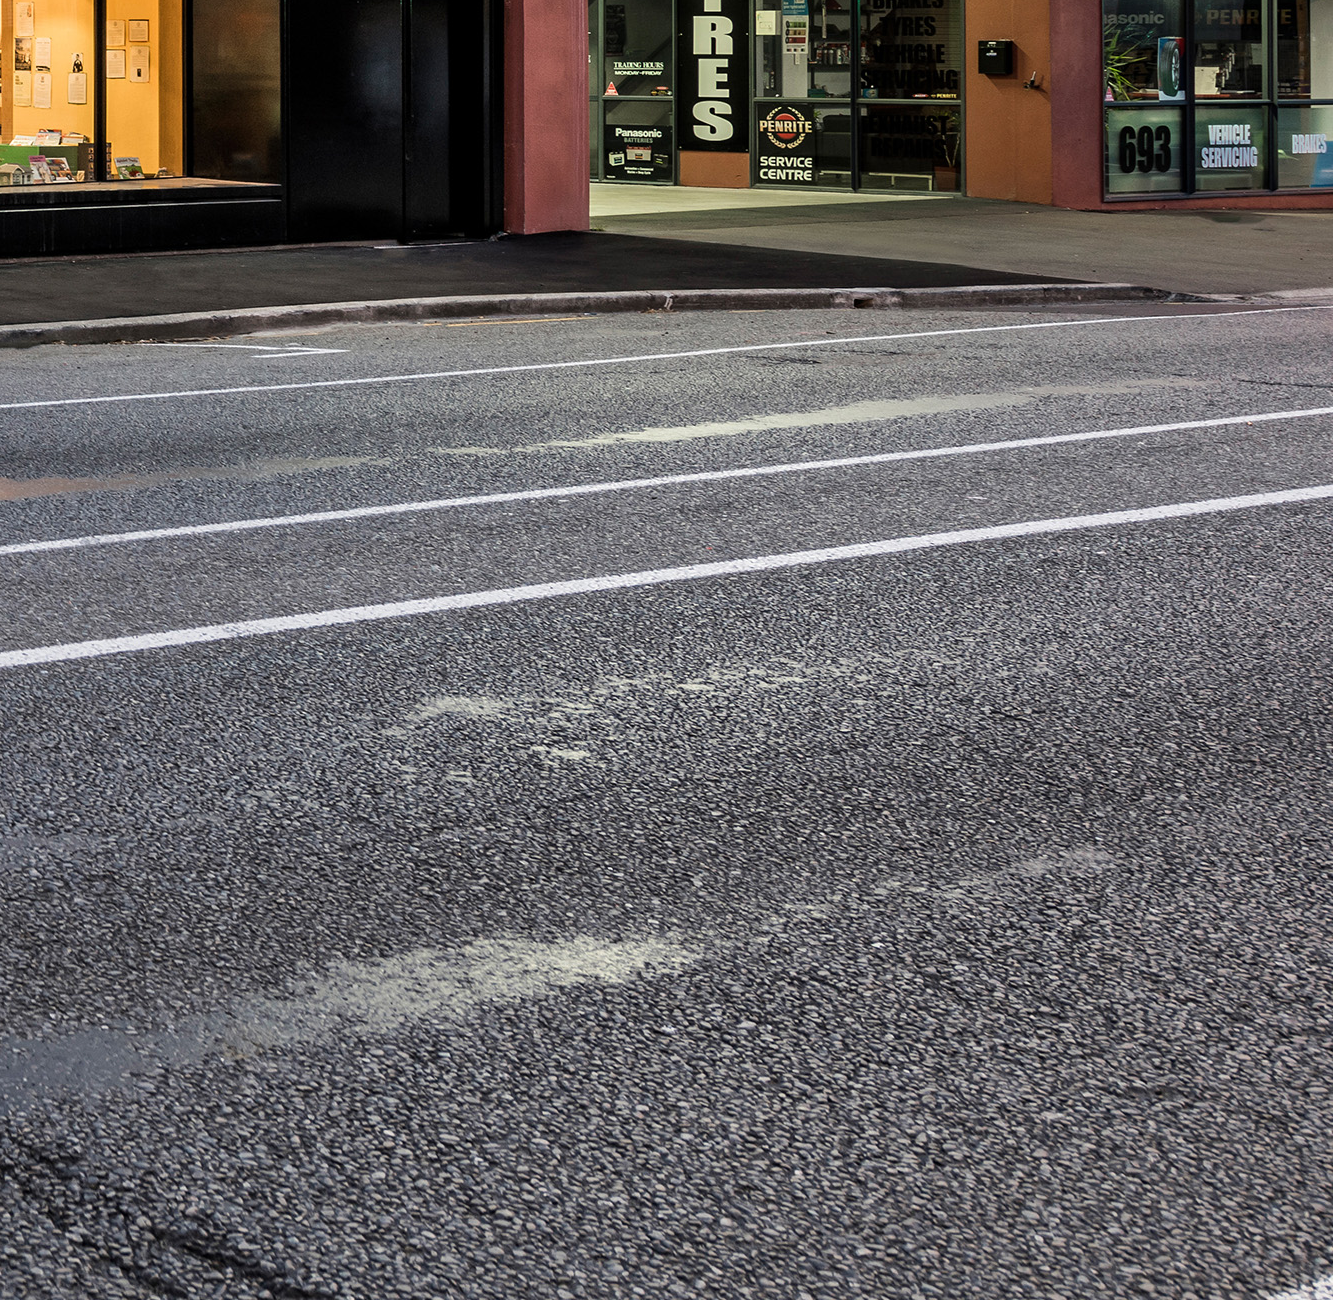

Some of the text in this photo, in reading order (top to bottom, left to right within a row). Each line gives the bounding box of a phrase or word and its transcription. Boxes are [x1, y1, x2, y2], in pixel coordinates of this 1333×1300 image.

[879, 16, 937, 37] TYRES
[1206, 8, 1293, 26] PENRE
[874, 43, 946, 65] VEHICLE
[860, 69, 959, 91] SERVICING
[615, 128, 662, 138] Panasonic
[760, 120, 812, 133] PENRITE
[1208, 124, 1251, 145] VEHICLE
[1119, 125, 1172, 173] 693
[1292, 134, 1328, 154] BRAKES
[760, 156, 813, 168] SERVICE
[1202, 147, 1258, 168] SERVICING
[760, 169, 813, 181] CENTRE
